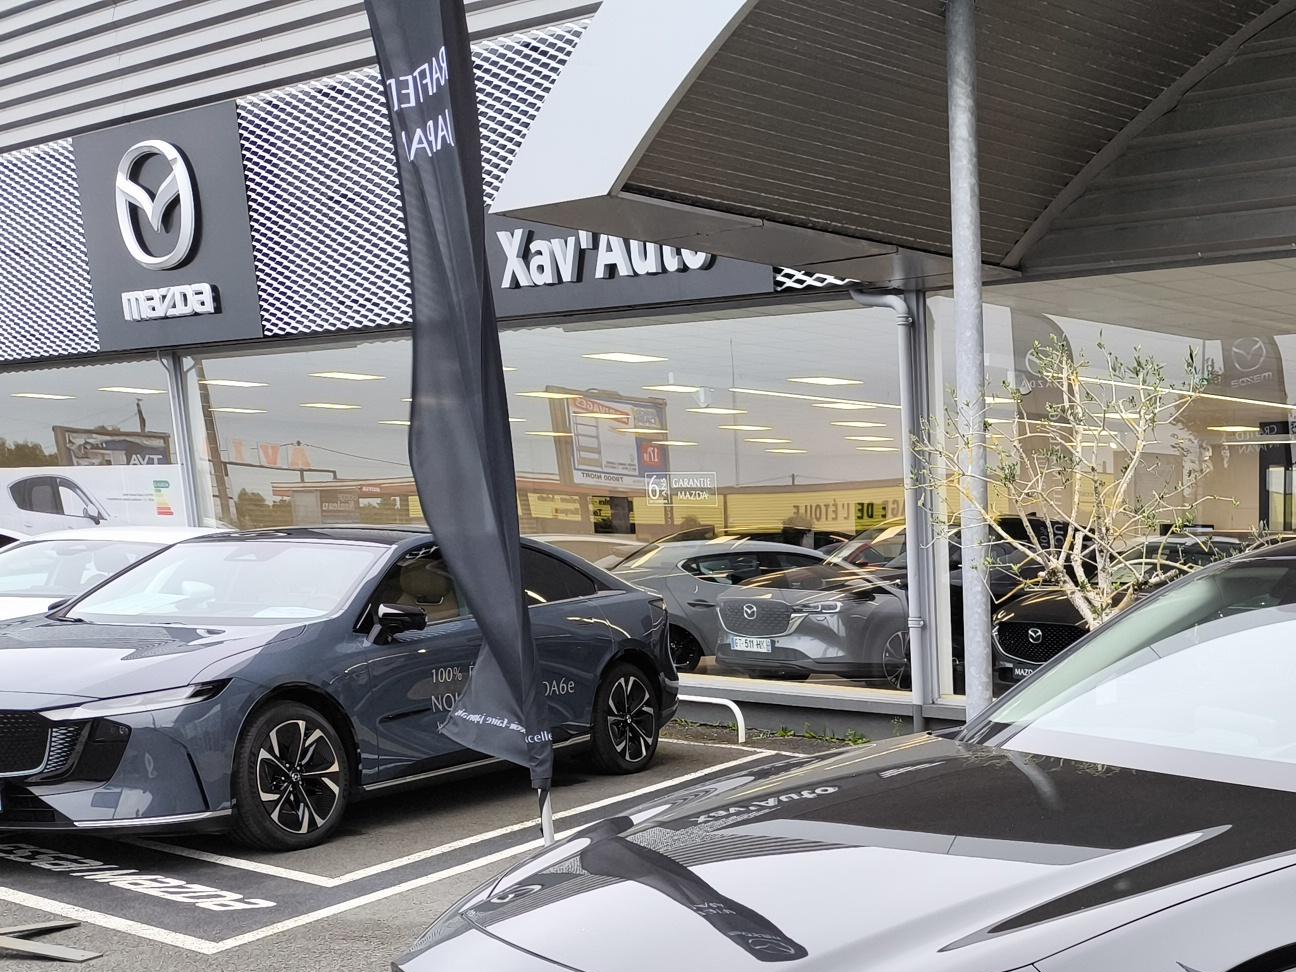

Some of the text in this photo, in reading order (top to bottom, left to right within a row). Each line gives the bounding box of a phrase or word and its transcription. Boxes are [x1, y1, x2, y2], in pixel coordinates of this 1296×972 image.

[672, 477, 712, 488] GARANTIE
[677, 490, 709, 500] MAZDA
[432, 667, 463, 683] 100%
